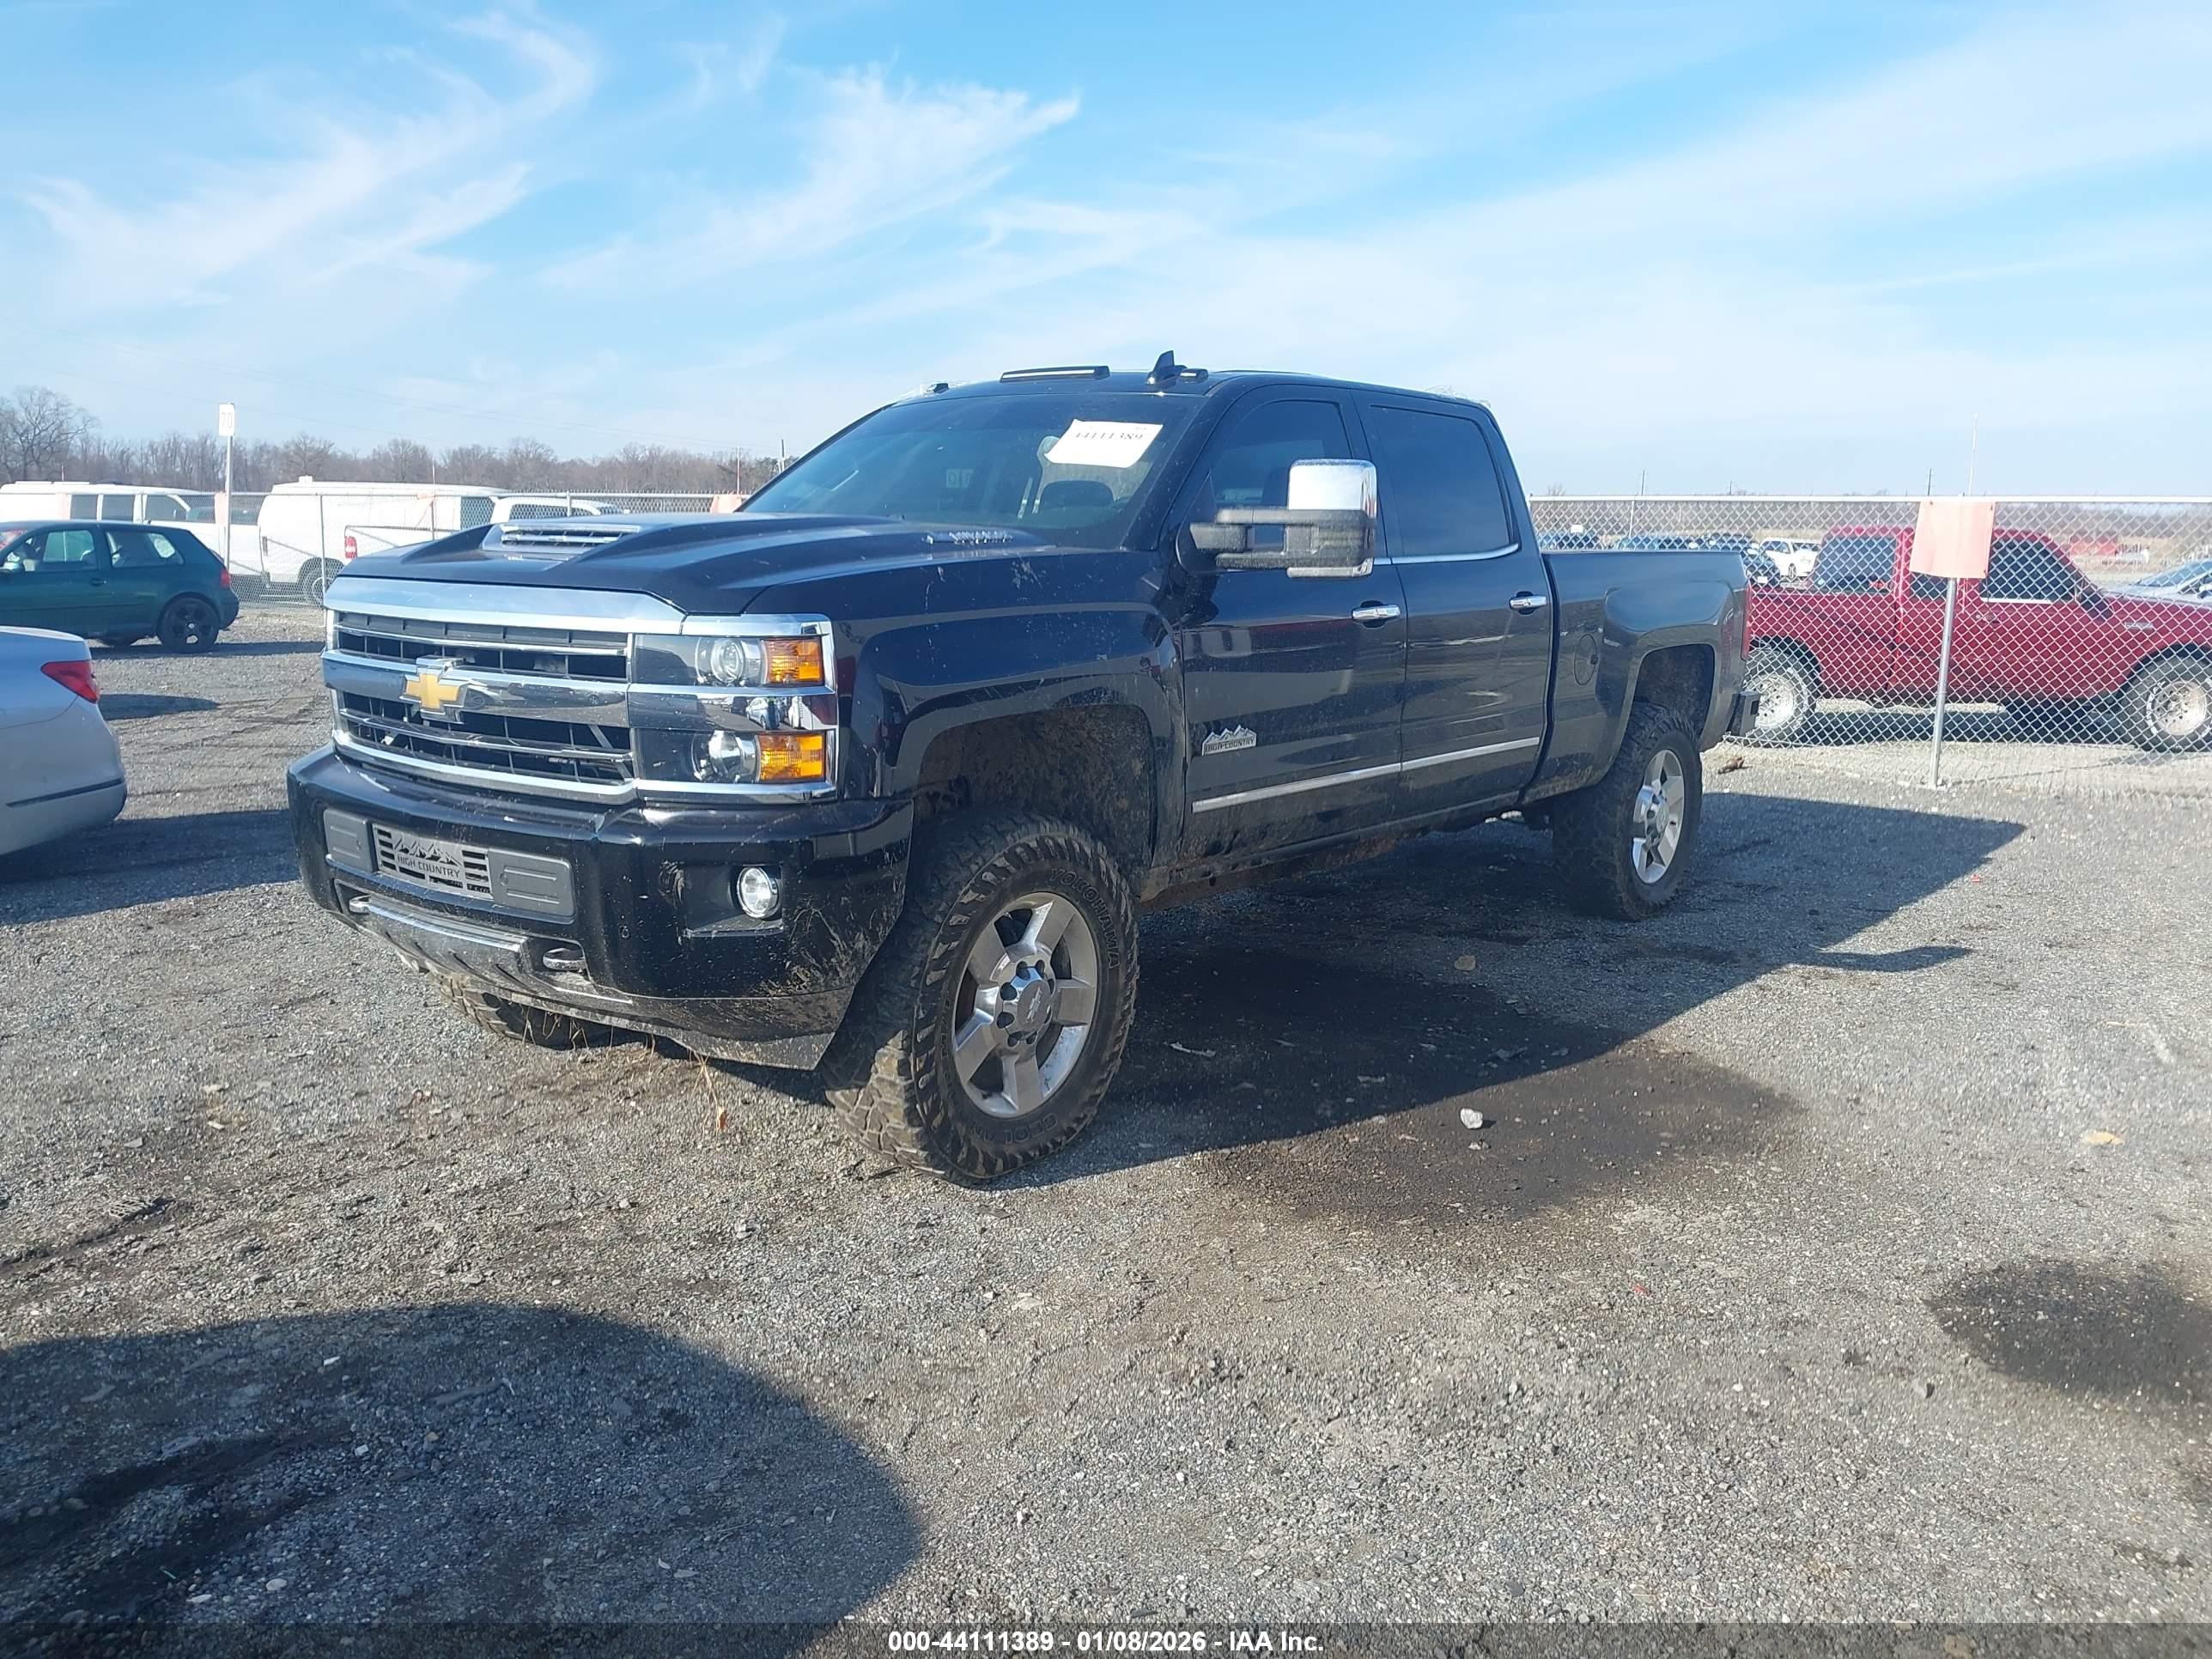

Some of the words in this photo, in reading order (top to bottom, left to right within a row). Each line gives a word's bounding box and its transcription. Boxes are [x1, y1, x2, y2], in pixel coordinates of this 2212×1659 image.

[1225, 738, 1255, 750] COUNTRY
[398, 855, 416, 867] HIGH
[418, 861, 460, 878] COUNTRY
[1049, 868, 1120, 969] YOKOHAMA
